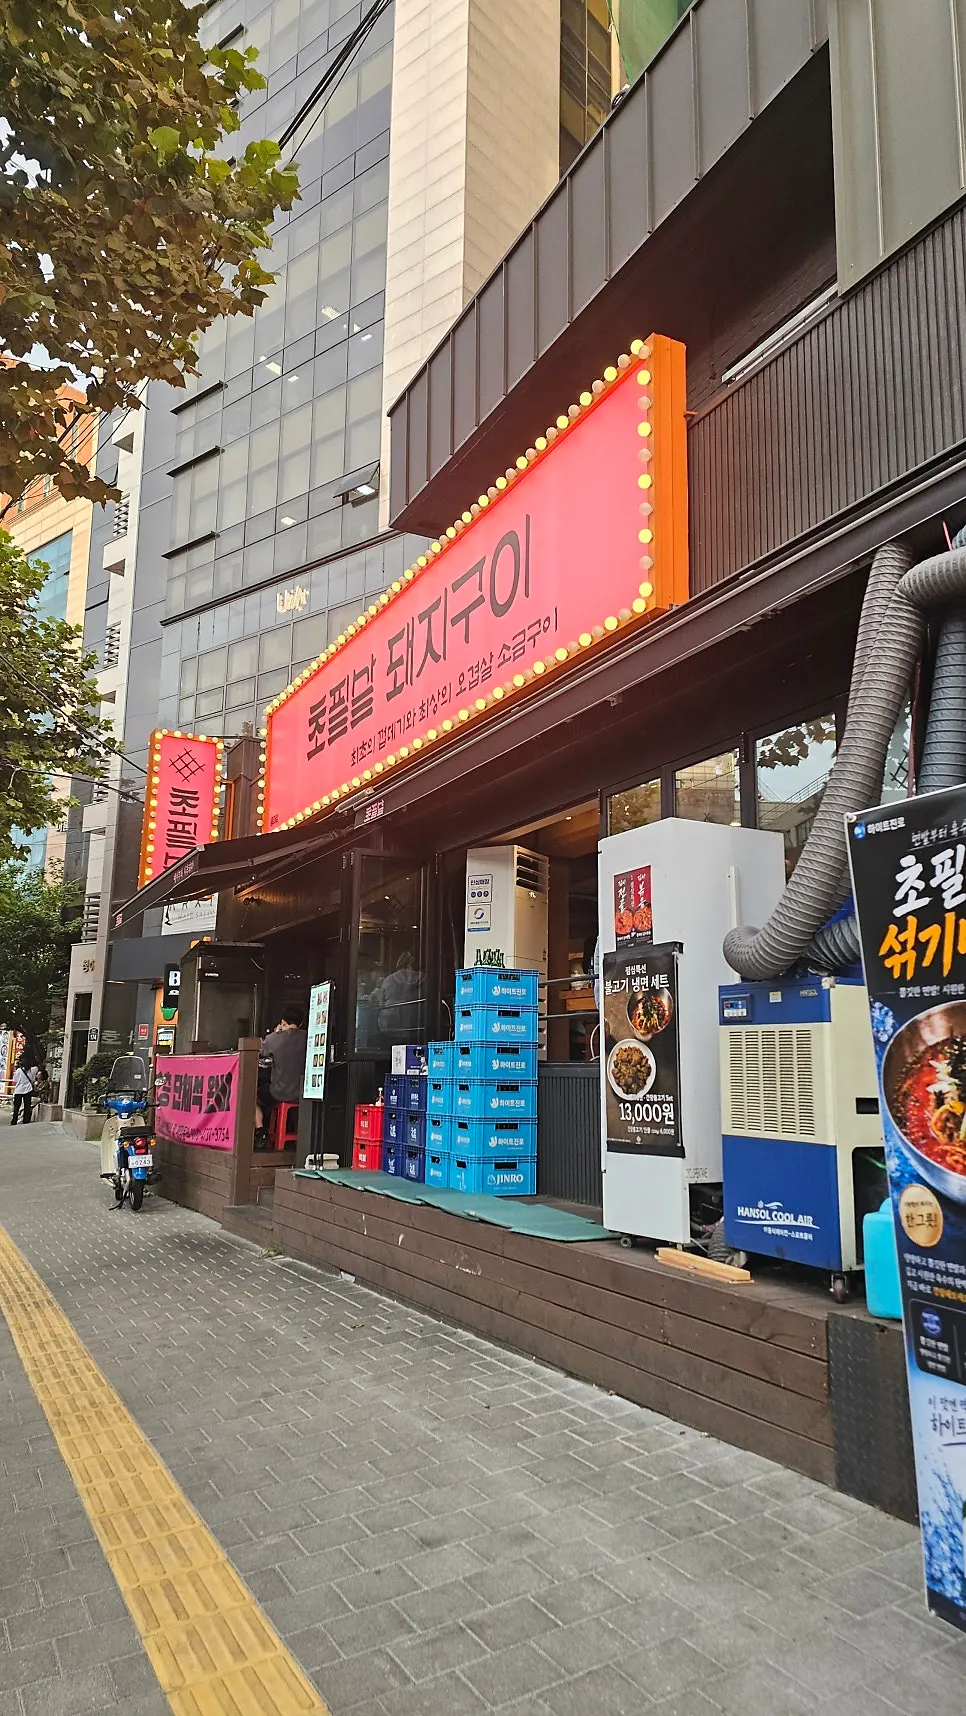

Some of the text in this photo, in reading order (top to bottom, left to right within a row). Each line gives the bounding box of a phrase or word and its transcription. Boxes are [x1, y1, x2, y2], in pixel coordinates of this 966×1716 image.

[386, 513, 531, 703] 돼지구이
[351, 735, 376, 768] 최초의
[419, 682, 451, 722] 최상의
[456, 651, 494, 697] 오겹살
[497, 606, 558, 668] 소금구이
[867, 816, 906, 835] 하이트진로
[604, 973, 670, 996] 불고기 냉면 세트
[618, 1102, 675, 1126] 13,000원
[496, 1173, 524, 1186] JINRO
[737, 1206, 814, 1226] HANSOL COOL AIR
